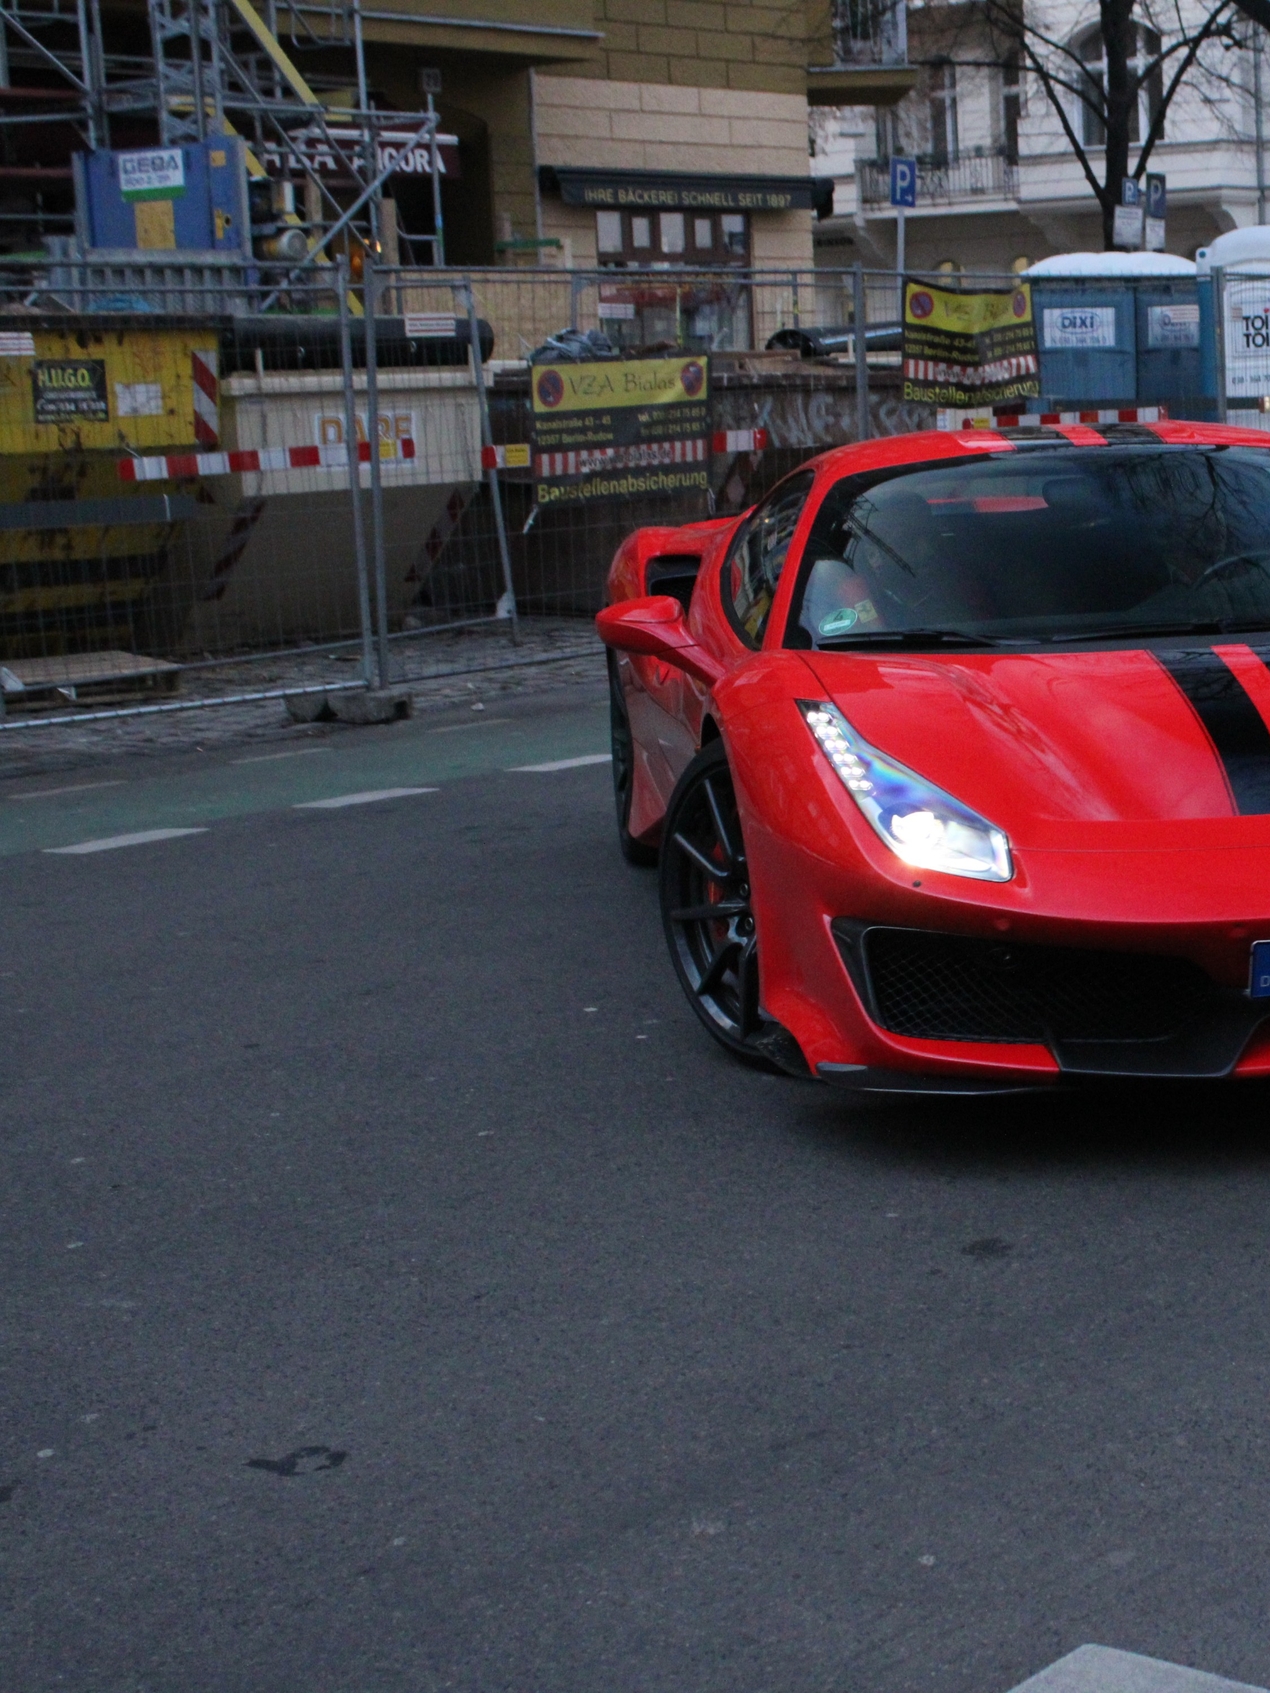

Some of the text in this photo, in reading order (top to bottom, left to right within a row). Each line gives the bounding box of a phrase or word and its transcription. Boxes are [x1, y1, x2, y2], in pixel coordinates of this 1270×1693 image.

[896, 164, 911, 200] P
[584, 188, 614, 203] IHRE
[617, 187, 678, 205] BÄCKEREI
[681, 191, 735, 207] SCHNELL
[737, 193, 763, 207] SEIT
[1242, 312, 1269, 332] TOI
[1243, 333, 1270, 348] TOI
[569, 372, 676, 396] VZA Bialas
[537, 471, 708, 503] Baustellenabsicherung
[1260, 975, 1270, 988] D
